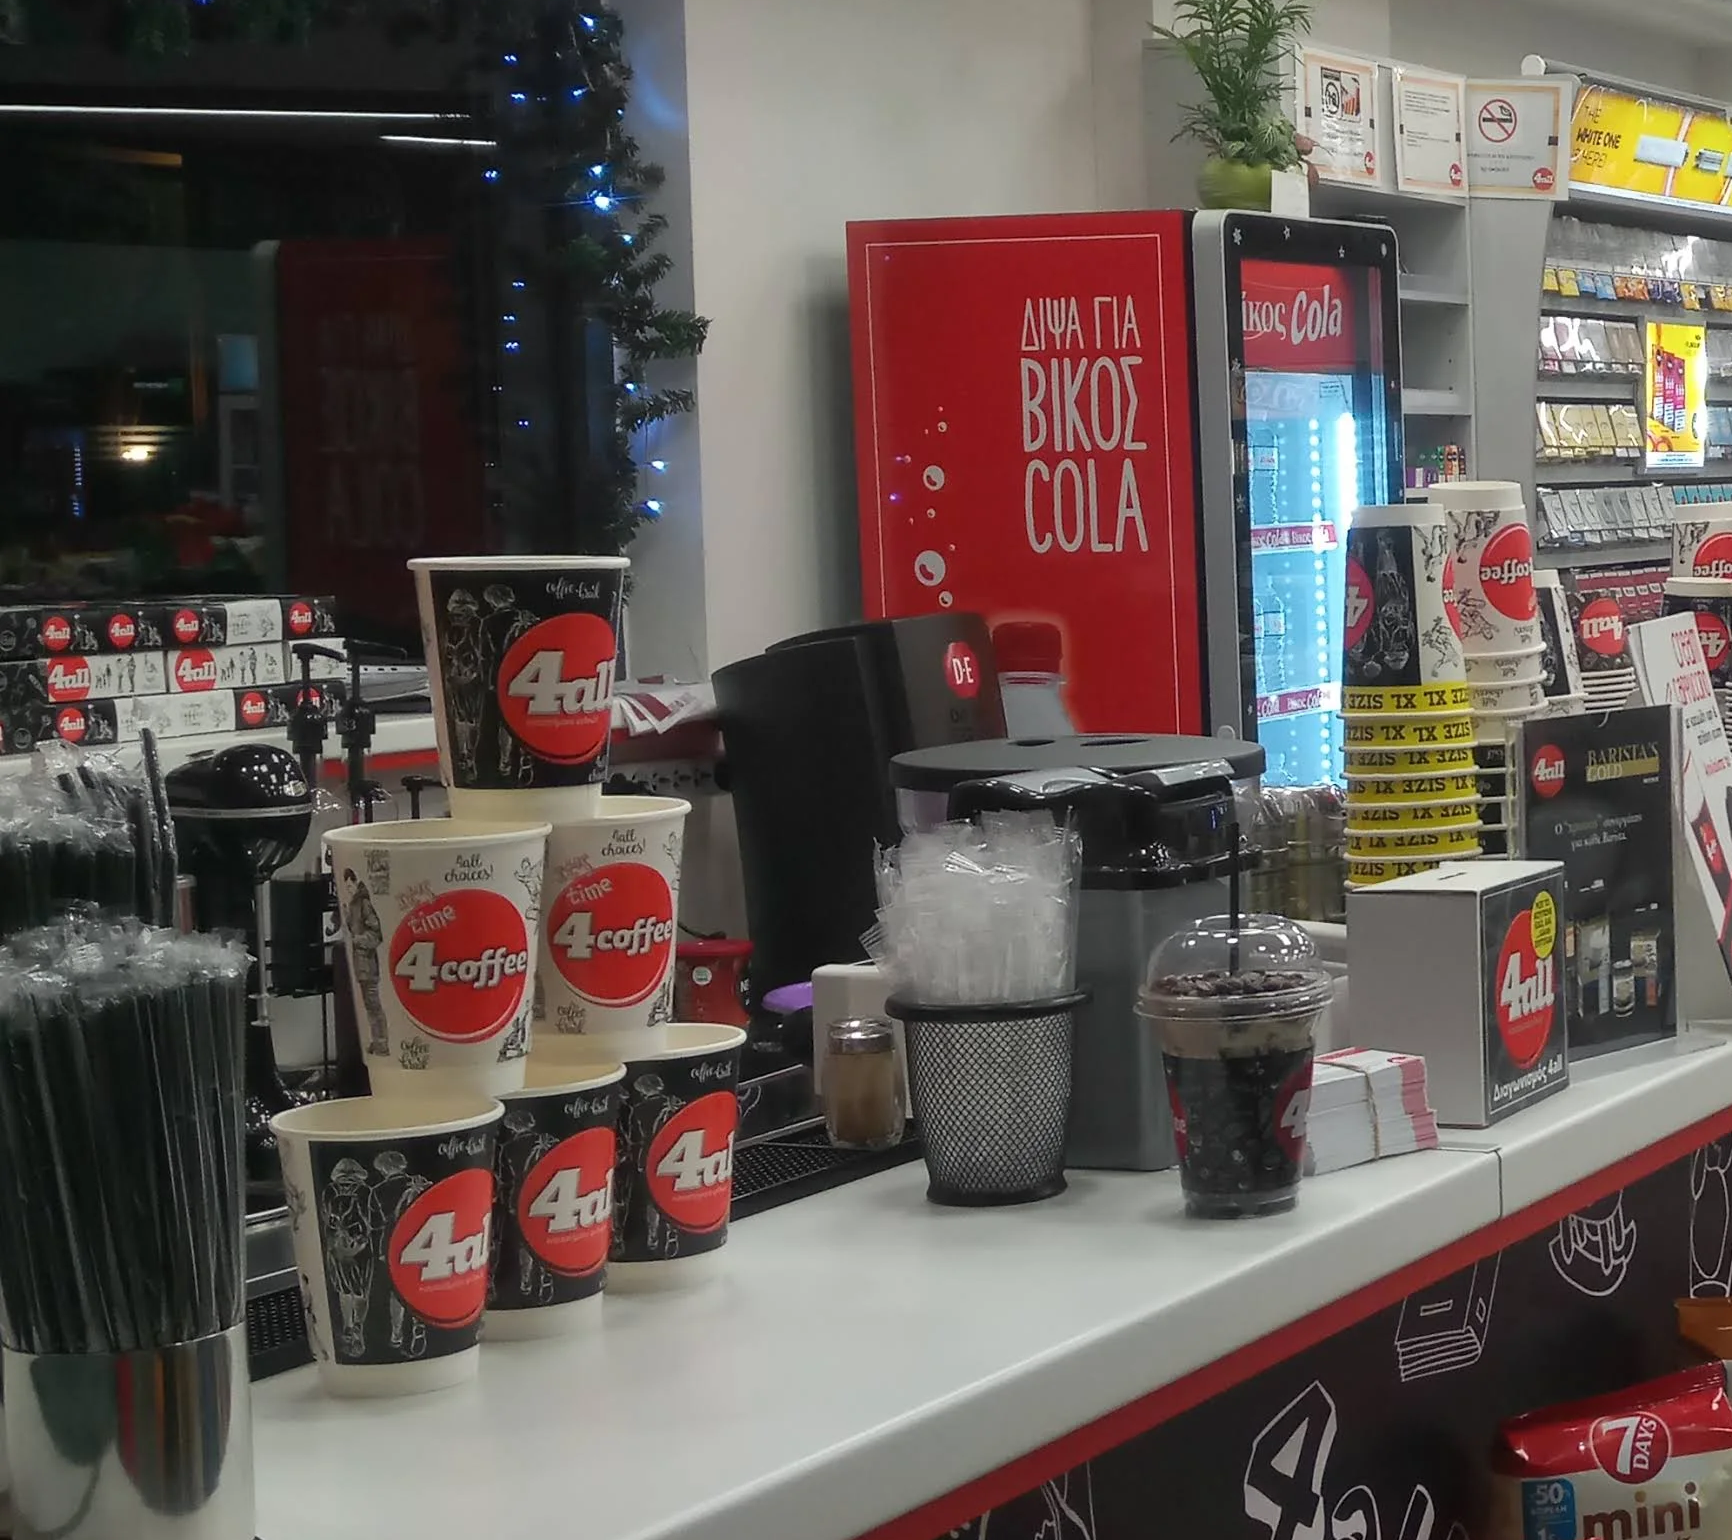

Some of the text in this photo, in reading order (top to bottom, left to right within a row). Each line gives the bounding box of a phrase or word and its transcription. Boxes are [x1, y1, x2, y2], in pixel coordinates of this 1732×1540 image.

[1575, 128, 1622, 149] WHITE ONE
[1021, 294, 1141, 352] ΔΙΨΑ ΓΙΑ
[1241, 285, 1343, 345] ίκος Cola
[1020, 356, 1148, 454] ΒΙΚΟΣ
[1023, 458, 1149, 555] COLA
[48, 665, 91, 690] 4all
[176, 658, 216, 681] 4all
[1533, 758, 1566, 782] 4all
[1587, 764, 1623, 780] GOLD
[600, 838, 647, 857] choices!
[444, 863, 496, 883] choices!
[565, 875, 614, 907] time
[407, 902, 457, 935] time
[1499, 951, 1555, 1023] 4all
[1493, 1052, 1564, 1102] Διαγωνισμός 4all
[1602, 1416, 1658, 1475] 7 DAYS
